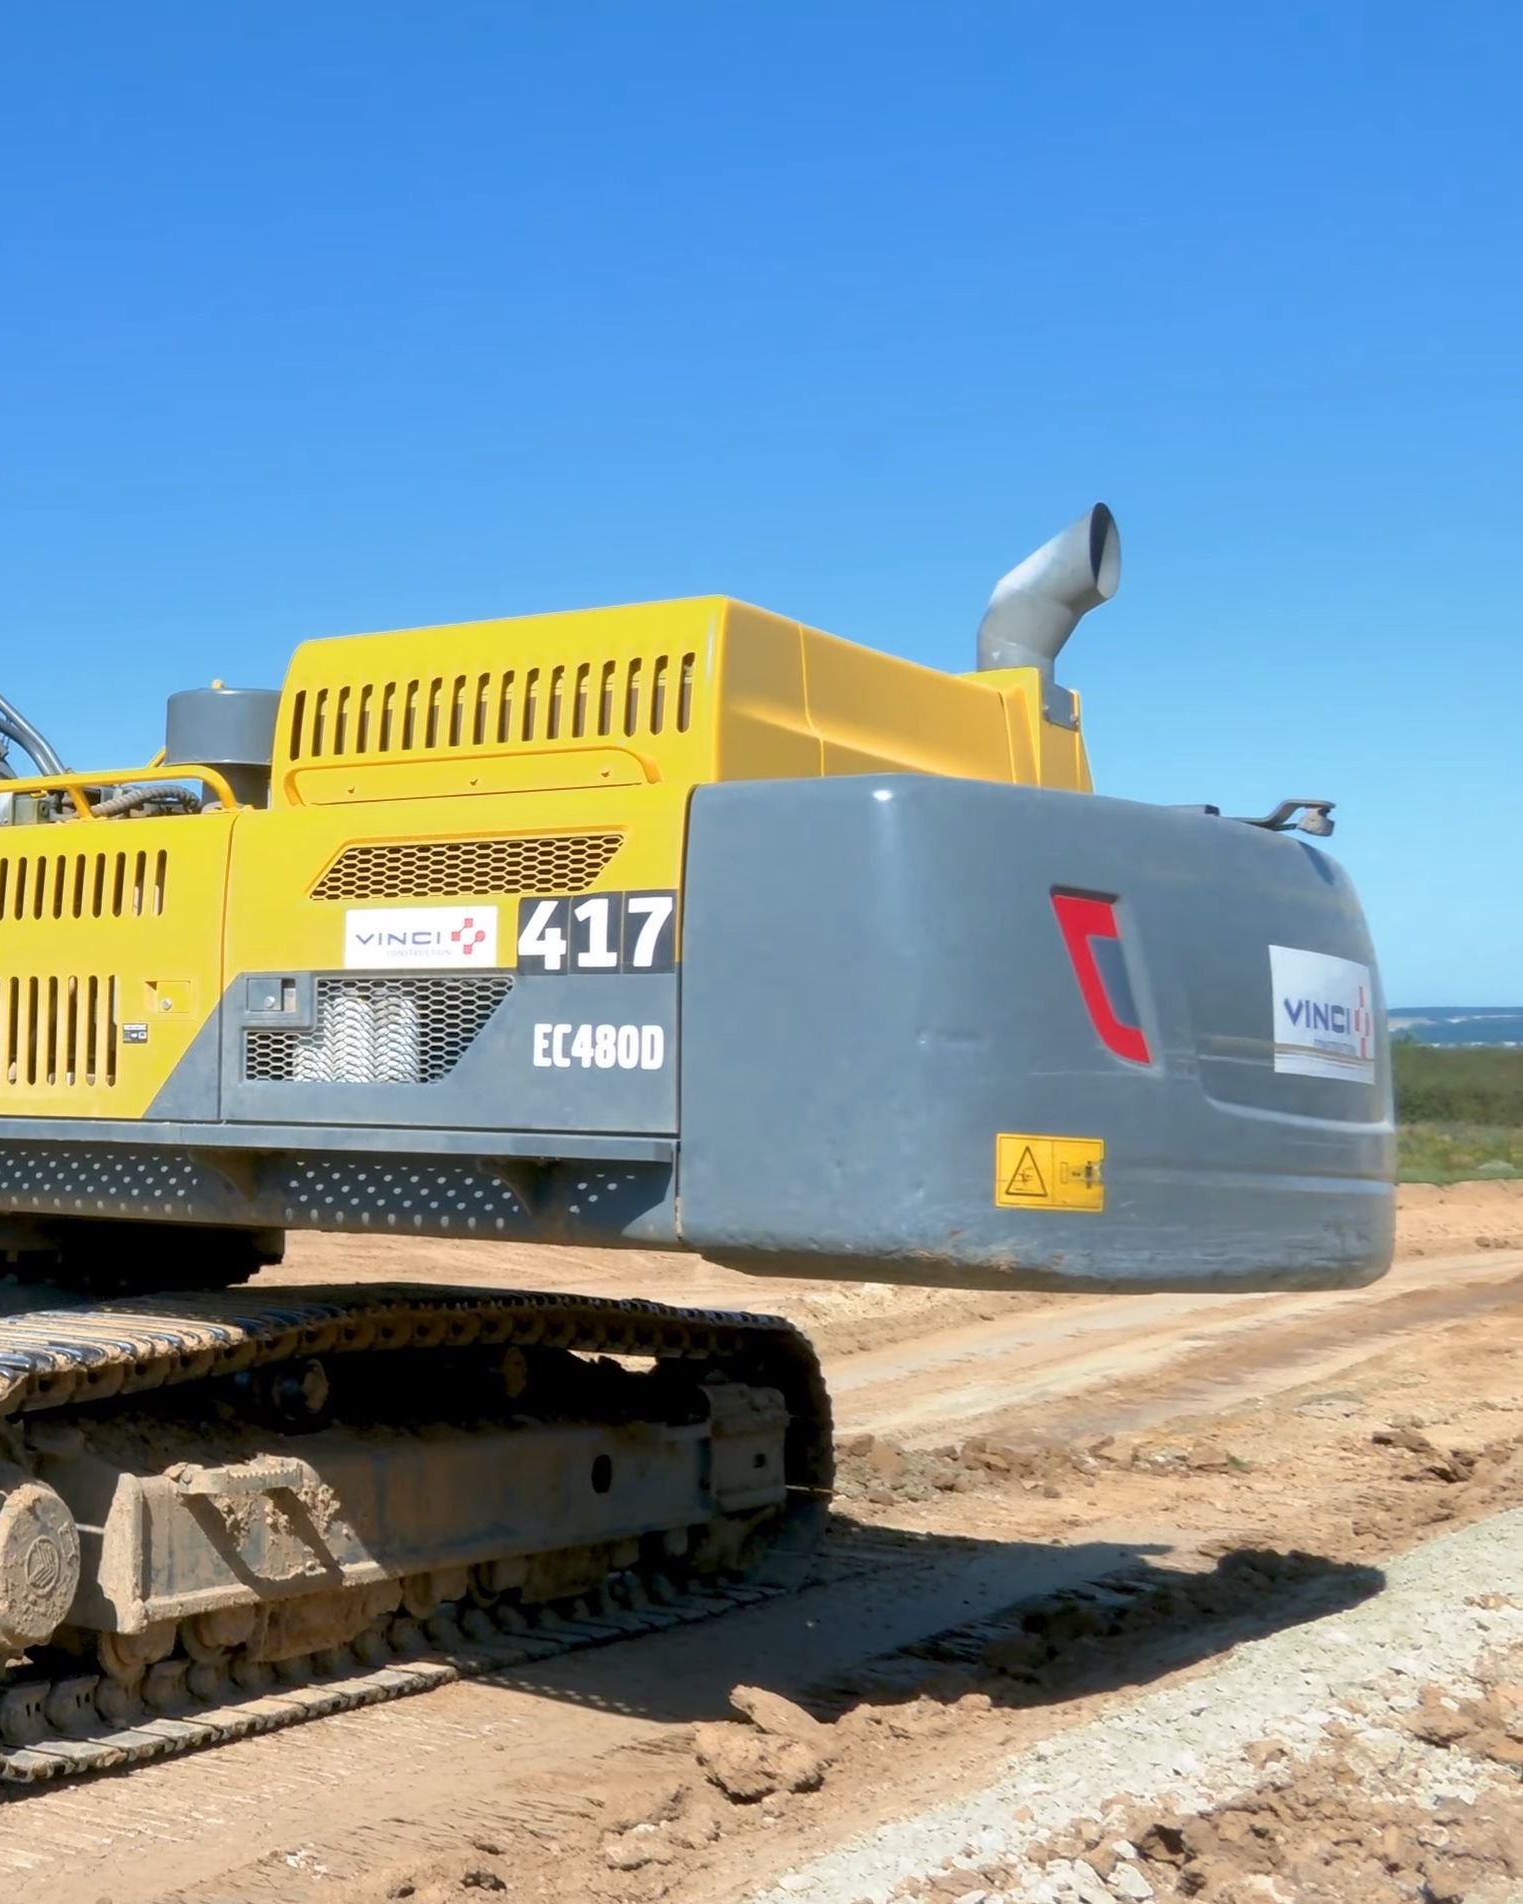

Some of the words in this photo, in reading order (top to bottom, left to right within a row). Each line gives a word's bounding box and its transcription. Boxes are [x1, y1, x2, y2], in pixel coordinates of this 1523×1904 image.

[355, 931, 441, 946] VINCI
[518, 896, 673, 970] 417
[1283, 998, 1351, 1035] VINCI
[533, 1023, 665, 1070] EC480D
